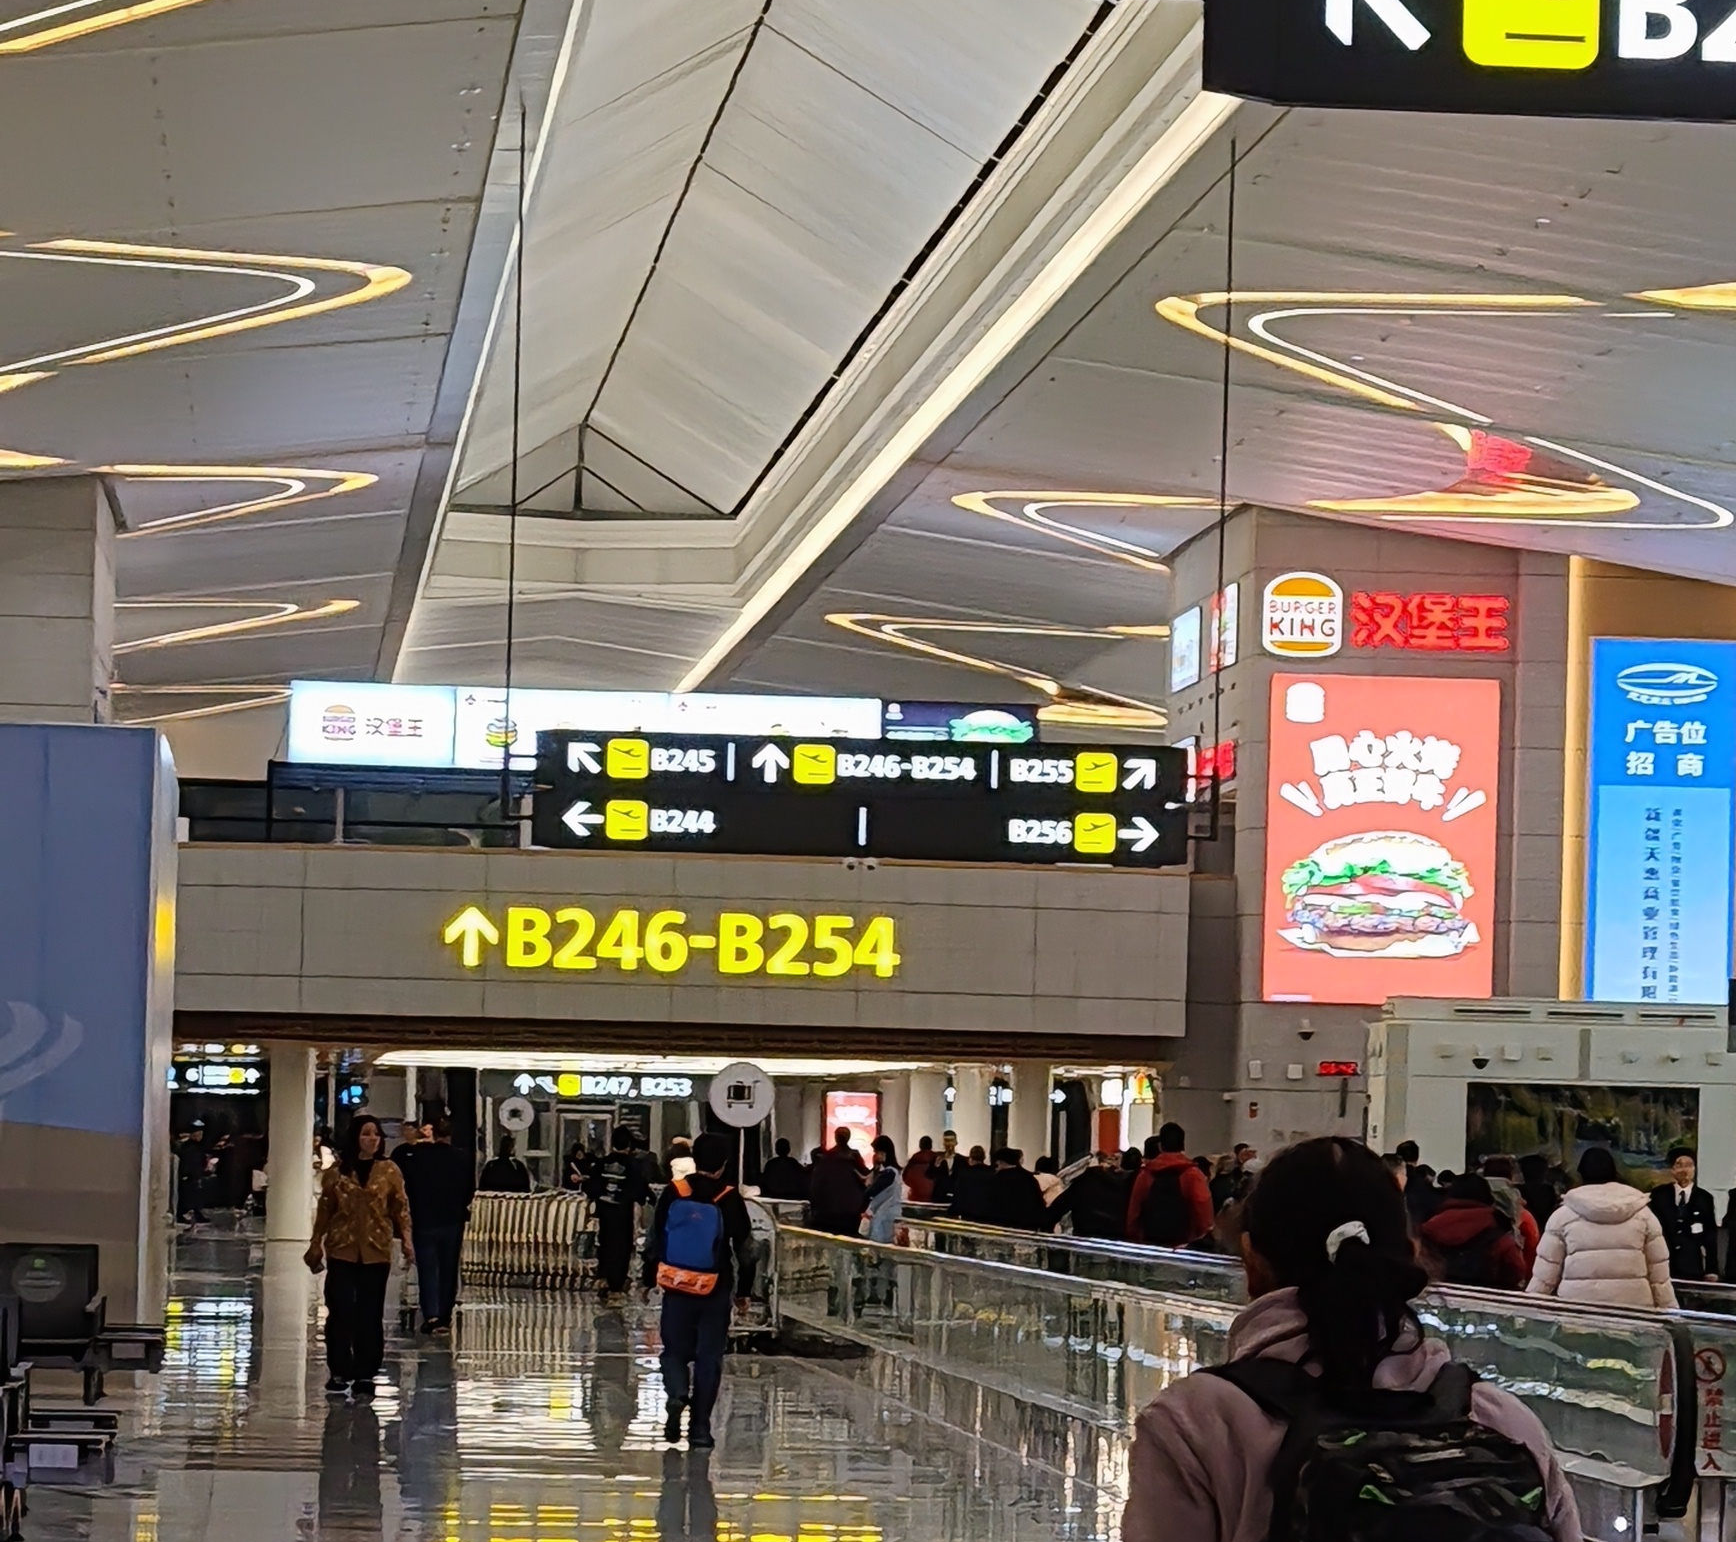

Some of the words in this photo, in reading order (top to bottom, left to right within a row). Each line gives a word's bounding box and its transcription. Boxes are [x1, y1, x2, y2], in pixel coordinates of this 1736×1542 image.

[1268, 599, 1337, 615] BURGER
[1268, 616, 1336, 637] KING
[1350, 590, 1511, 652] 汉堡王
[1625, 720, 1708, 745] 广告位
[650, 748, 716, 773] B245
[837, 754, 977, 780] B246-B254
[1010, 759, 1075, 784] B255
[1626, 750, 1705, 777] 招商
[650, 809, 717, 834] B244
[1008, 819, 1074, 845] B256
[506, 906, 901, 978] B246-B254
